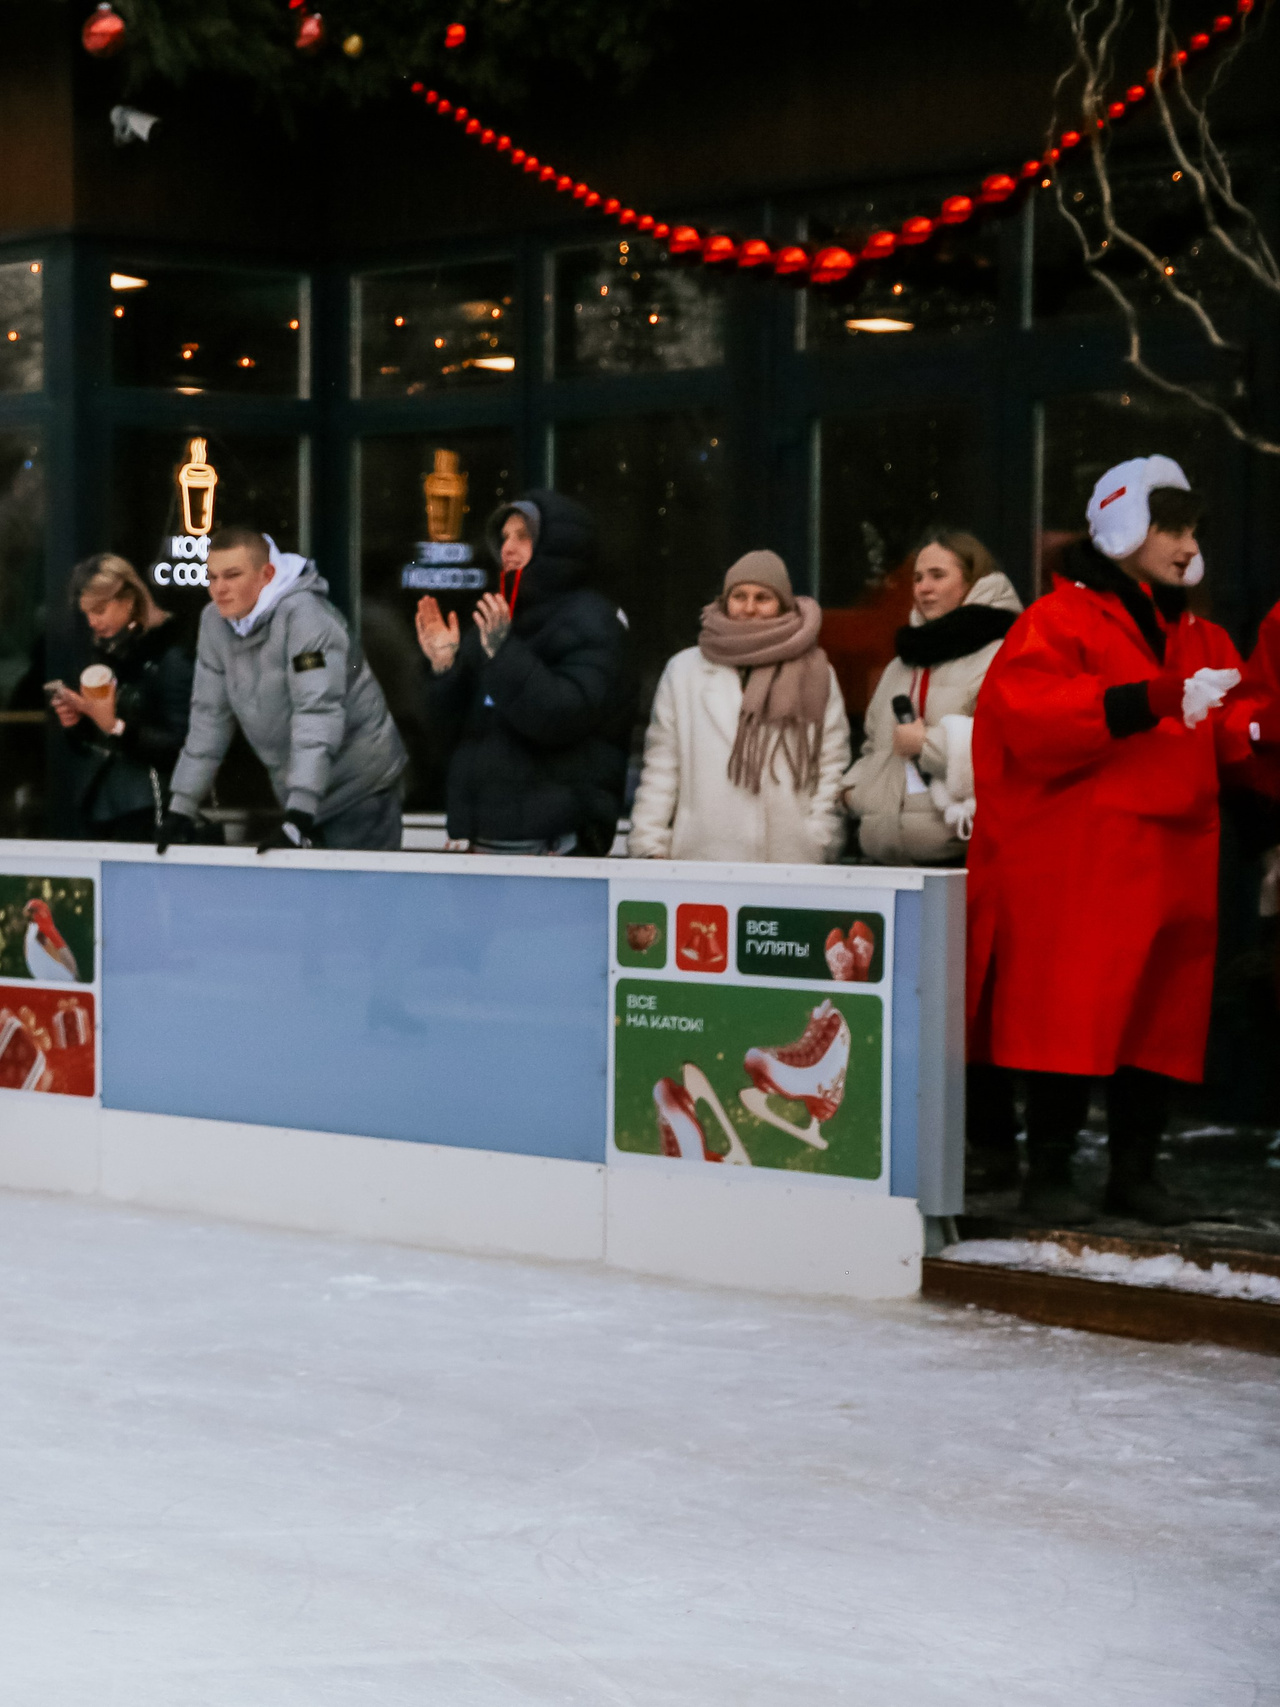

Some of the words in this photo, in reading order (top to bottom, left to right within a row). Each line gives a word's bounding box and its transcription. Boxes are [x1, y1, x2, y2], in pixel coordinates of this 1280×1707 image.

[746, 919, 779, 936] ВСЕ
[745, 939, 810, 958] ГУЛЯТЬ!
[626, 993, 657, 1010] ВСЕ
[626, 1012, 649, 1028] НА
